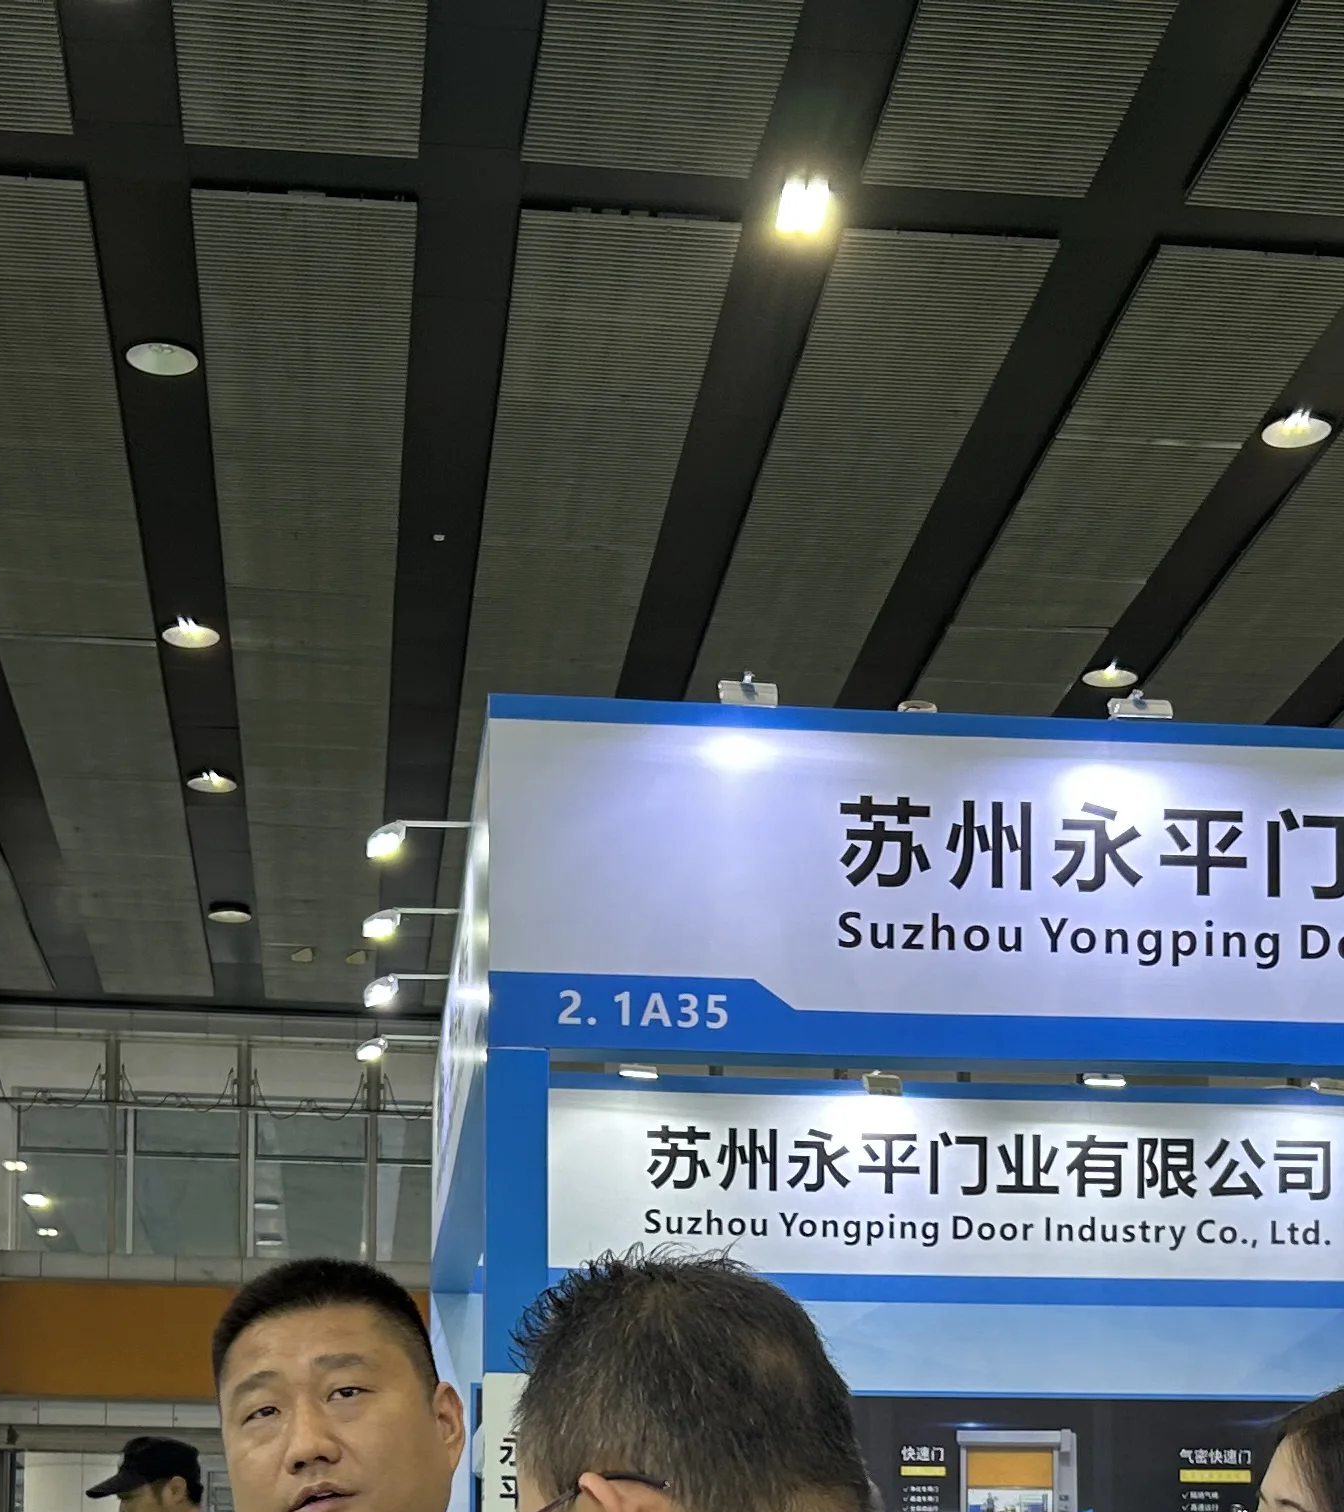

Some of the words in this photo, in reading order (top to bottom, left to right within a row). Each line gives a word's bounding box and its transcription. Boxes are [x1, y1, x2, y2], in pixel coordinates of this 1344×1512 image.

[837, 910, 1023, 953] Suzhou
[1041, 916, 1281, 969] Yongping
[647, 1125, 1331, 1201] 苏州永平门业有限公司
[644, 1208, 768, 1238] Suzhou
[779, 1212, 940, 1247] Yongping
[952, 1215, 1034, 1242] Door
[1045, 1216, 1186, 1251] Industry
[1197, 1219, 1257, 1249] Co.,
[1270, 1219, 1331, 1246] Ltd.
